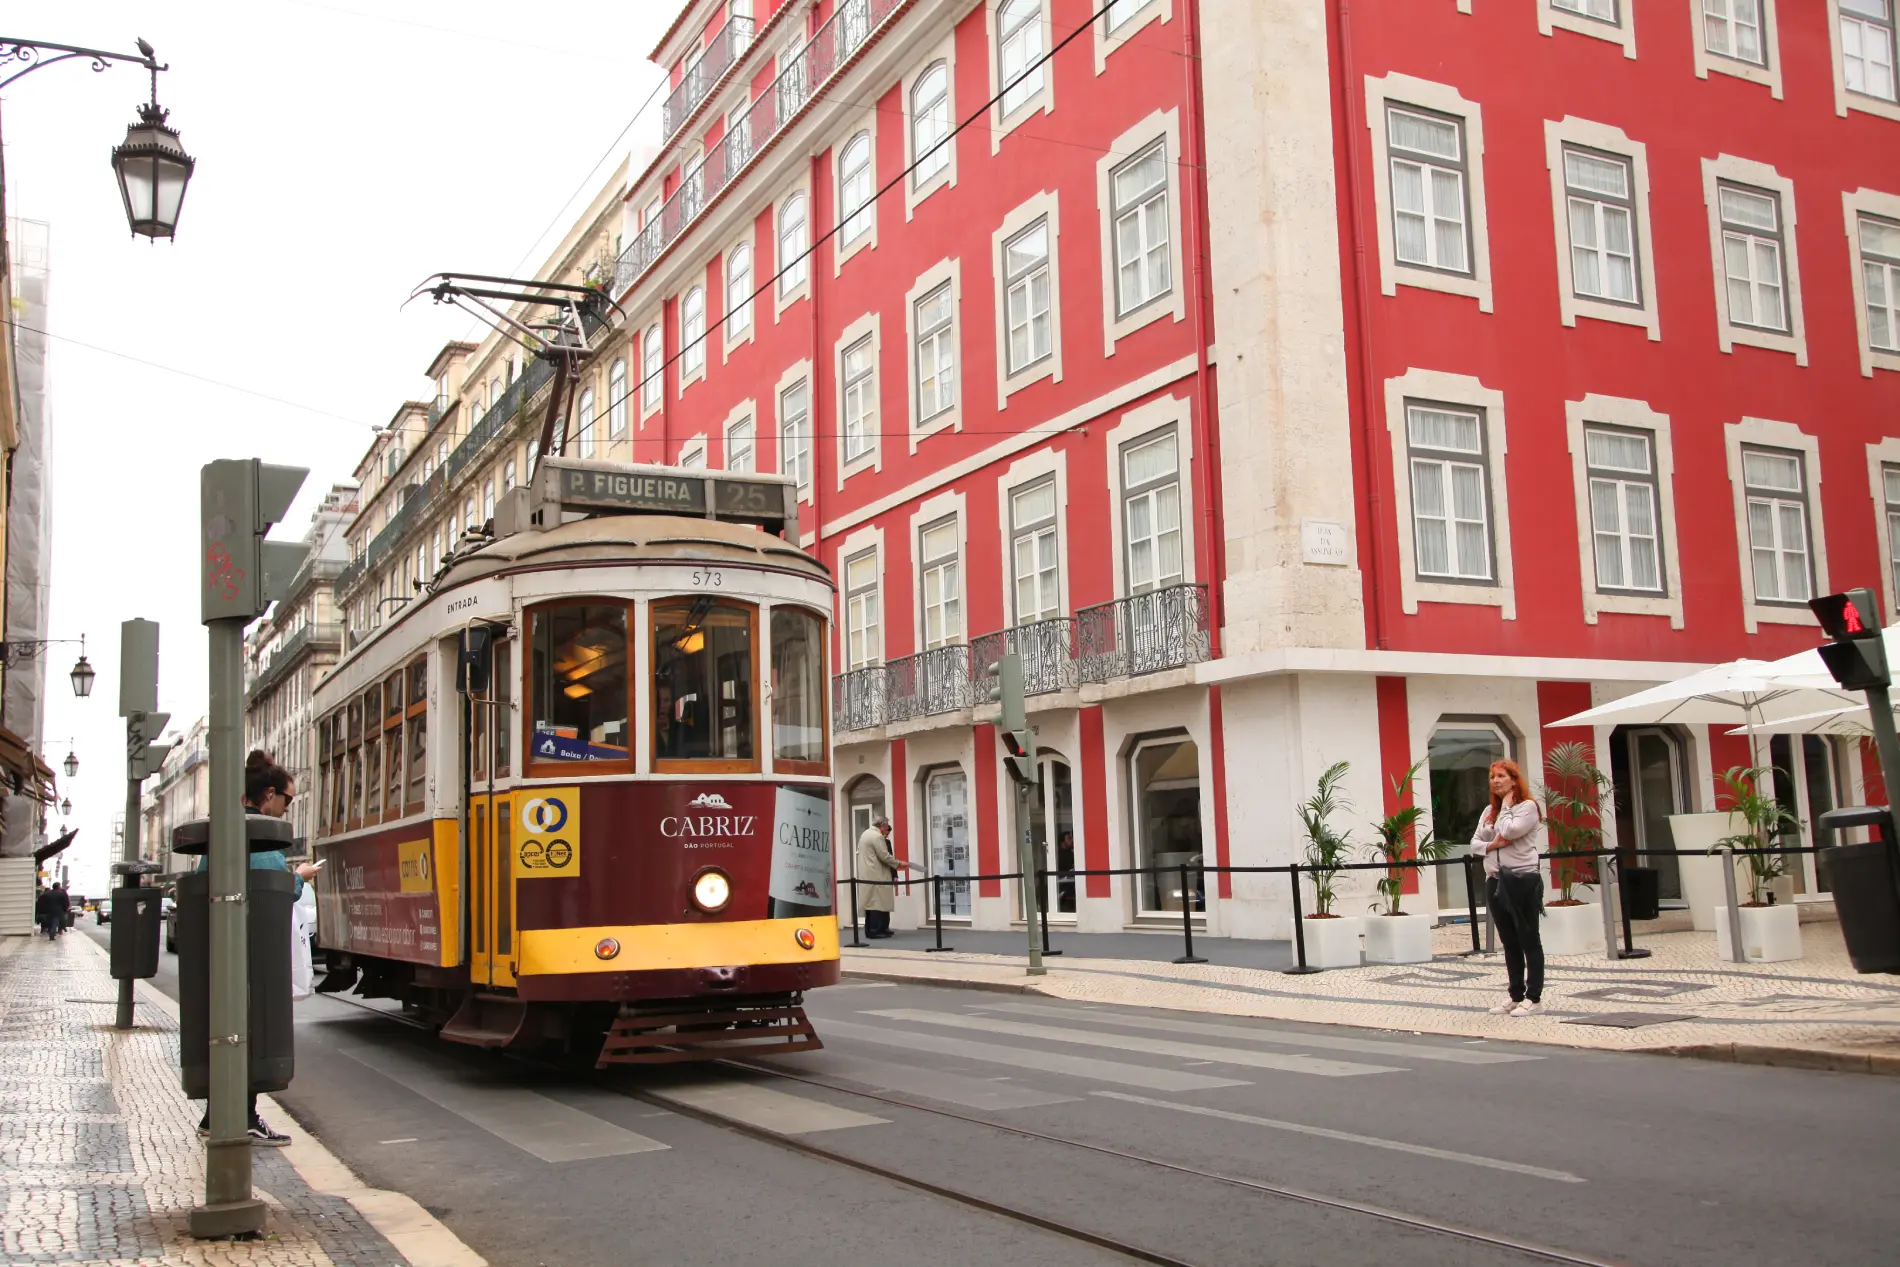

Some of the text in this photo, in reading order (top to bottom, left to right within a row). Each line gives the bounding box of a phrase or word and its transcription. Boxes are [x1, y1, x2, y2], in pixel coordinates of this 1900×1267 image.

[571, 472, 691, 500] P. FIGUEIRA
[727, 483, 766, 510] 25
[692, 571, 722, 586] 573
[447, 595, 478, 614] ENTRADA
[560, 749, 581, 759] Baixa
[660, 816, 754, 837] CABRIZ
[779, 822, 829, 852] CABRIZ
